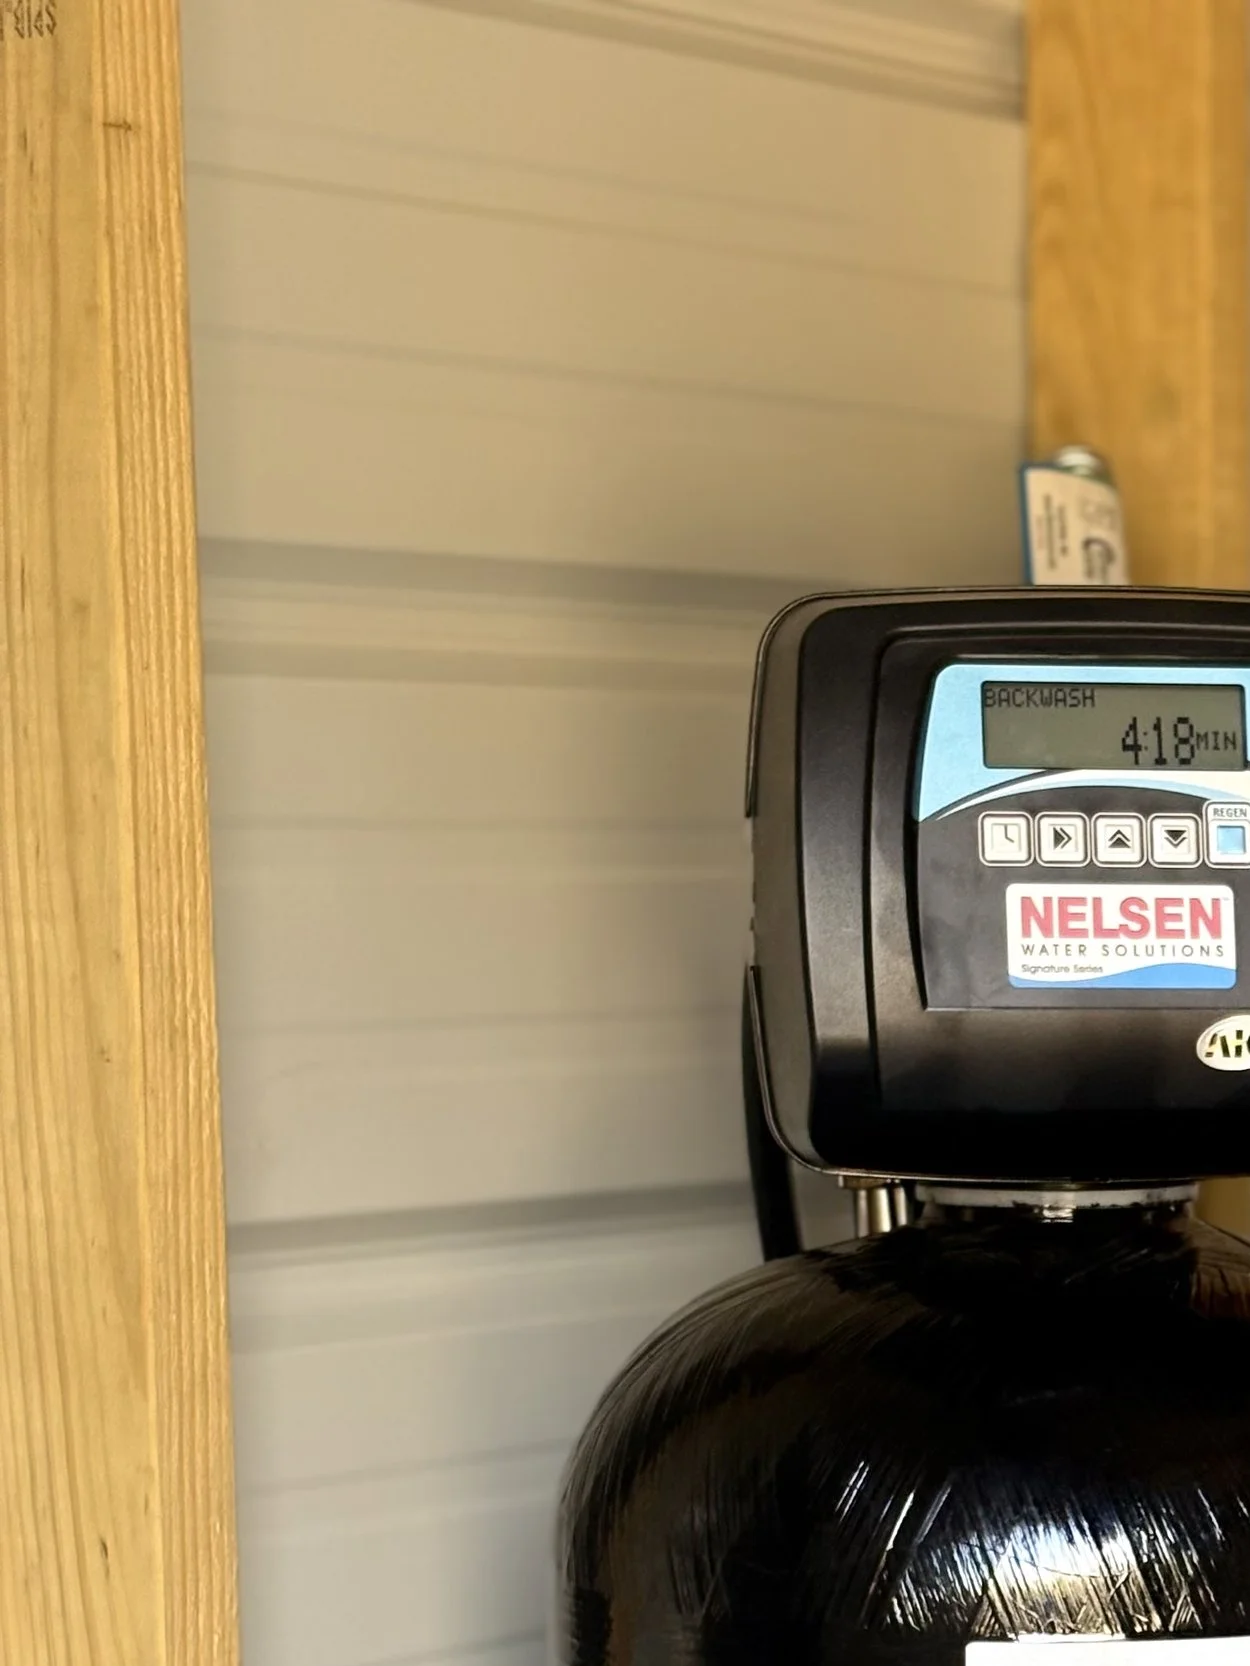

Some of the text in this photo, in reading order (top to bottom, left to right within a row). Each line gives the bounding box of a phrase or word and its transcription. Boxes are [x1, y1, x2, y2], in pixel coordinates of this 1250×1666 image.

[983, 688, 1096, 708] BACKWASH
[1121, 716, 1237, 765] 4:18 MIN
[1212, 807, 1248, 818] REGEN
[1020, 896, 1223, 940] NELSEN
[1021, 944, 1225, 957] WATER SOLUTIONS
[1021, 964, 1103, 975] Signature Series
